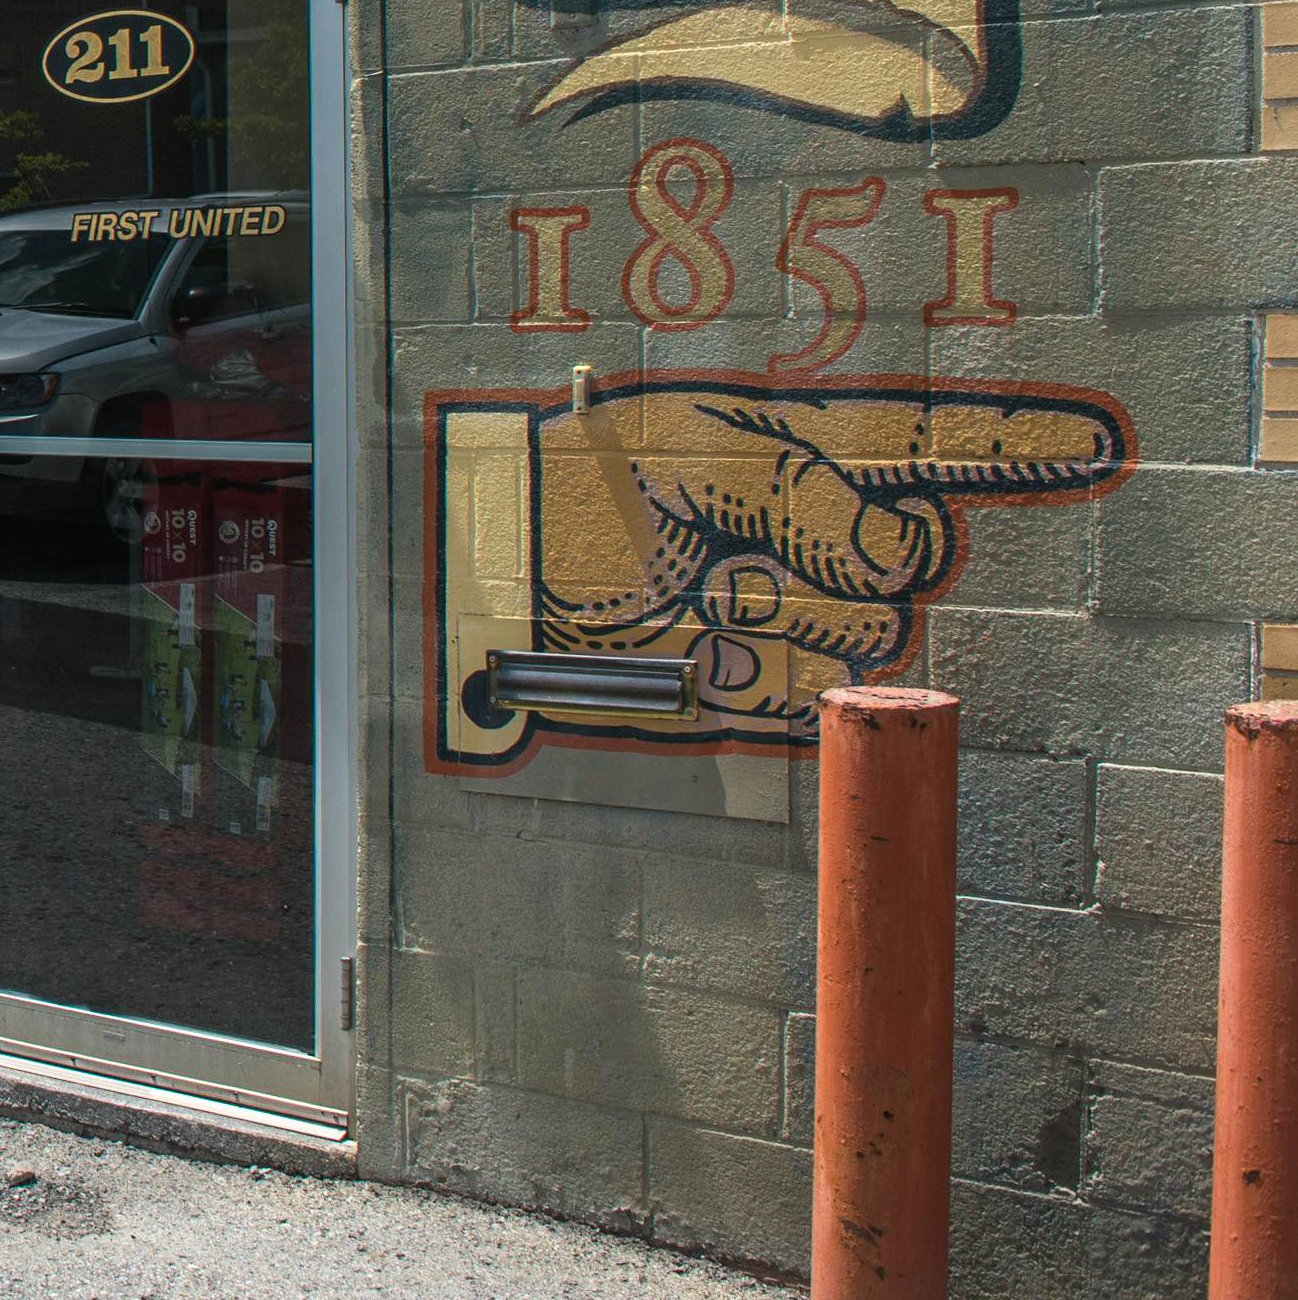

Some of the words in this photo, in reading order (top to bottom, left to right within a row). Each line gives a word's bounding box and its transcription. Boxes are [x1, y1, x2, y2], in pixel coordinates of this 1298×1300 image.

[65, 24, 170, 84] 211
[70, 211, 159, 242] FIRST
[167, 205, 287, 239] UNITED
[510, 137, 1019, 374] 1851
[187, 509, 197, 545] QUEST
[267, 519, 278, 556] QUEST
